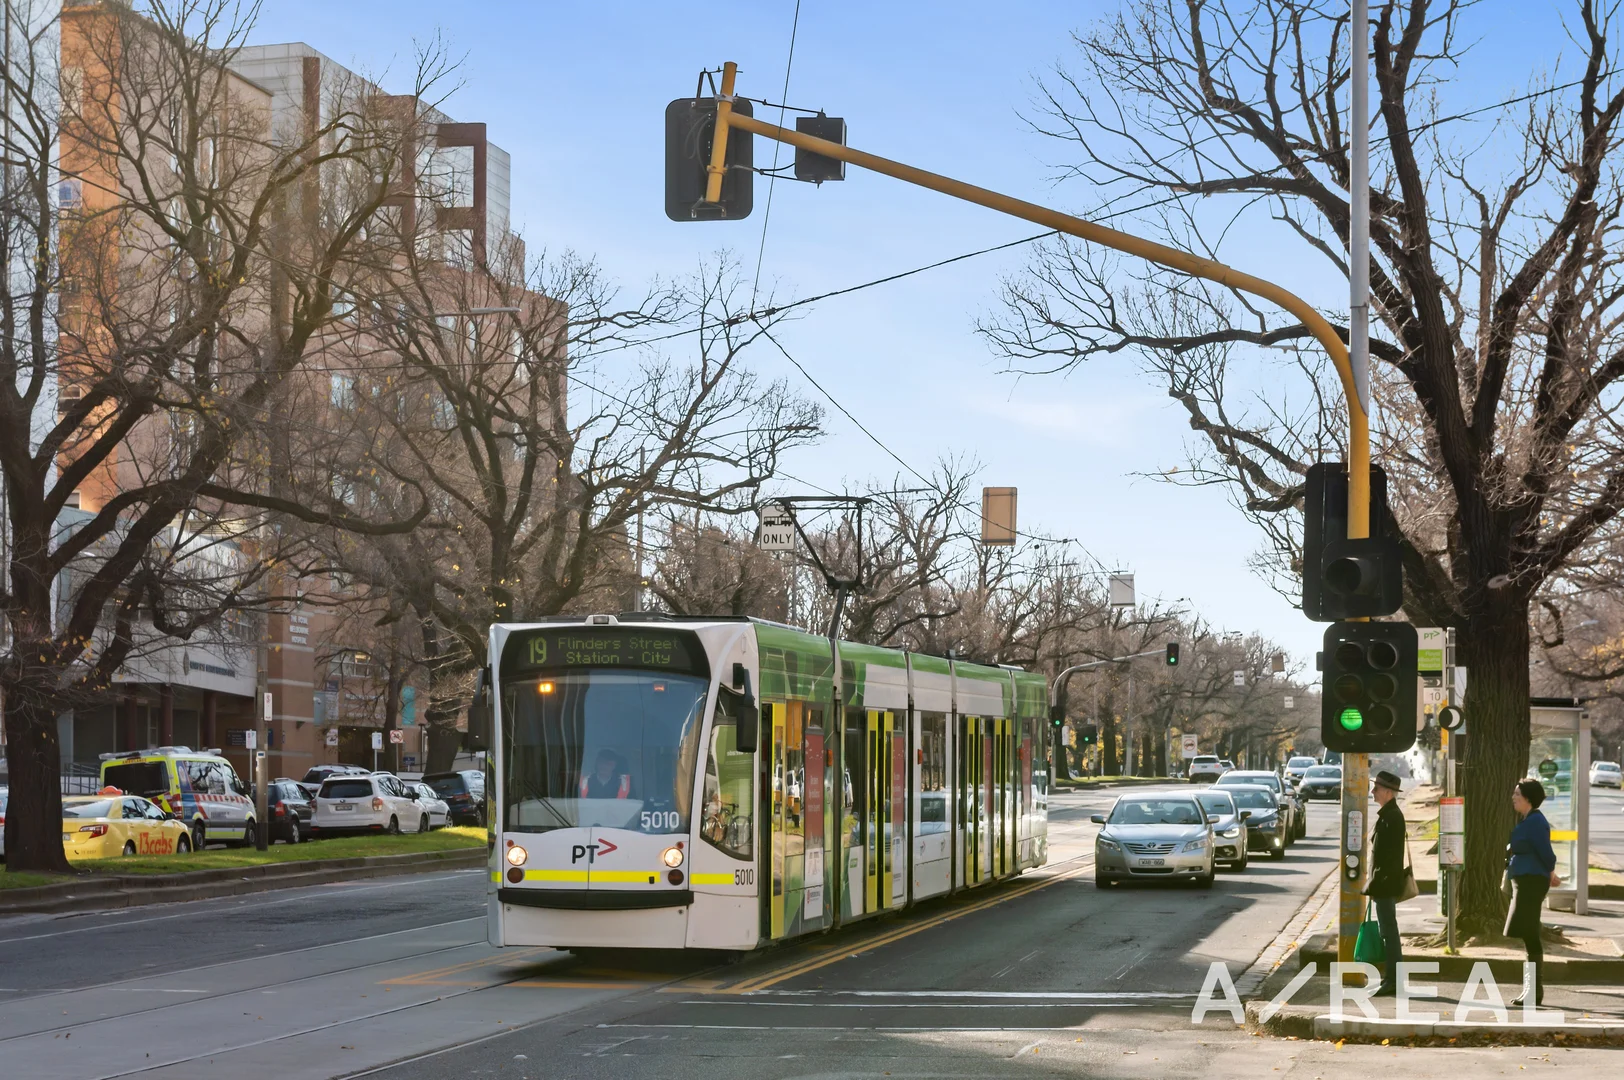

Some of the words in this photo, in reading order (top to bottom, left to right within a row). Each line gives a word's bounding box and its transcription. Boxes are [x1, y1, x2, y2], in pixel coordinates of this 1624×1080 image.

[763, 533, 792, 544] ONLY
[527, 636, 547, 664] 19
[557, 637, 621, 650] Flinders
[629, 637, 678, 650] Street
[566, 651, 620, 664] Station
[641, 651, 671, 664] City
[1430, 691, 1441, 701] 10
[640, 811, 680, 829] 5010
[139, 831, 173, 855] 13cabs
[734, 868, 754, 886] 5010
